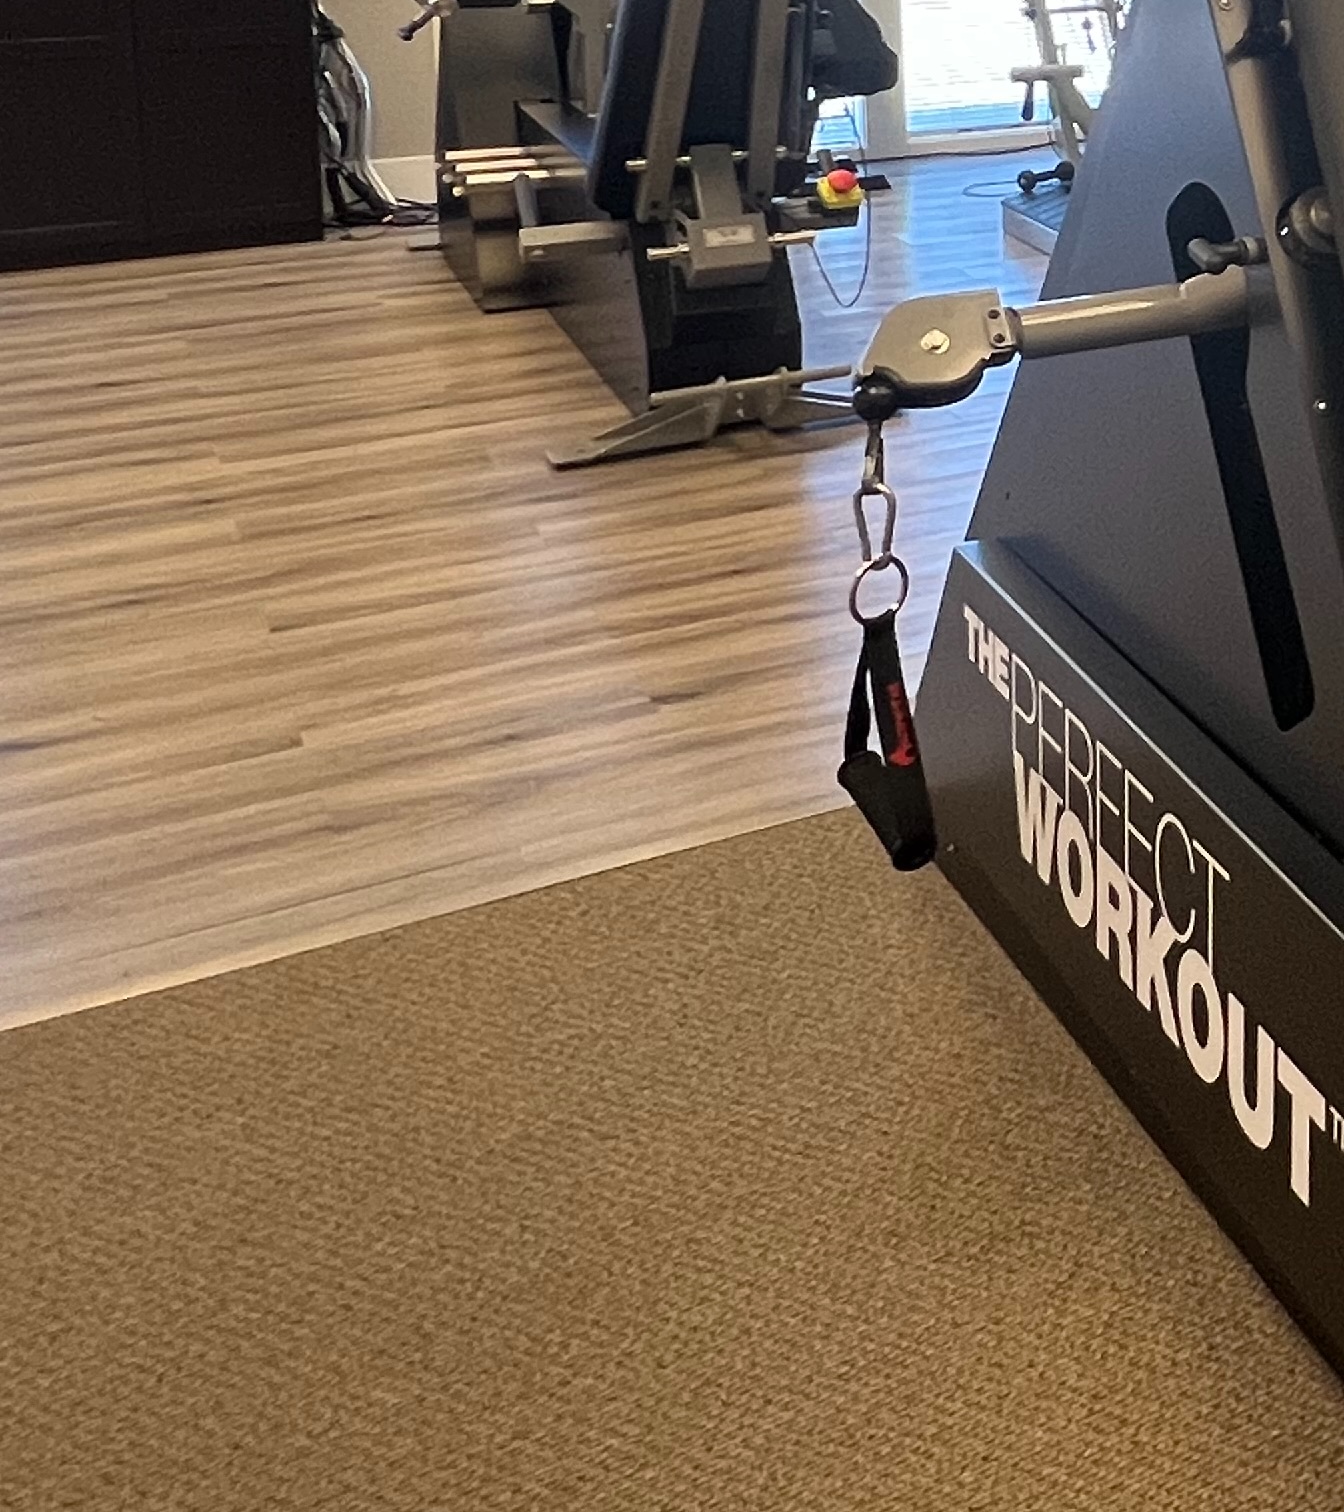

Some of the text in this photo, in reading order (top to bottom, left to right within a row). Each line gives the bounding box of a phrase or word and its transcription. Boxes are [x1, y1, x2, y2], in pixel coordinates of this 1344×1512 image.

[962, 603, 1231, 977] THE PERFECT
[1013, 751, 1327, 1208] WORKOUT
